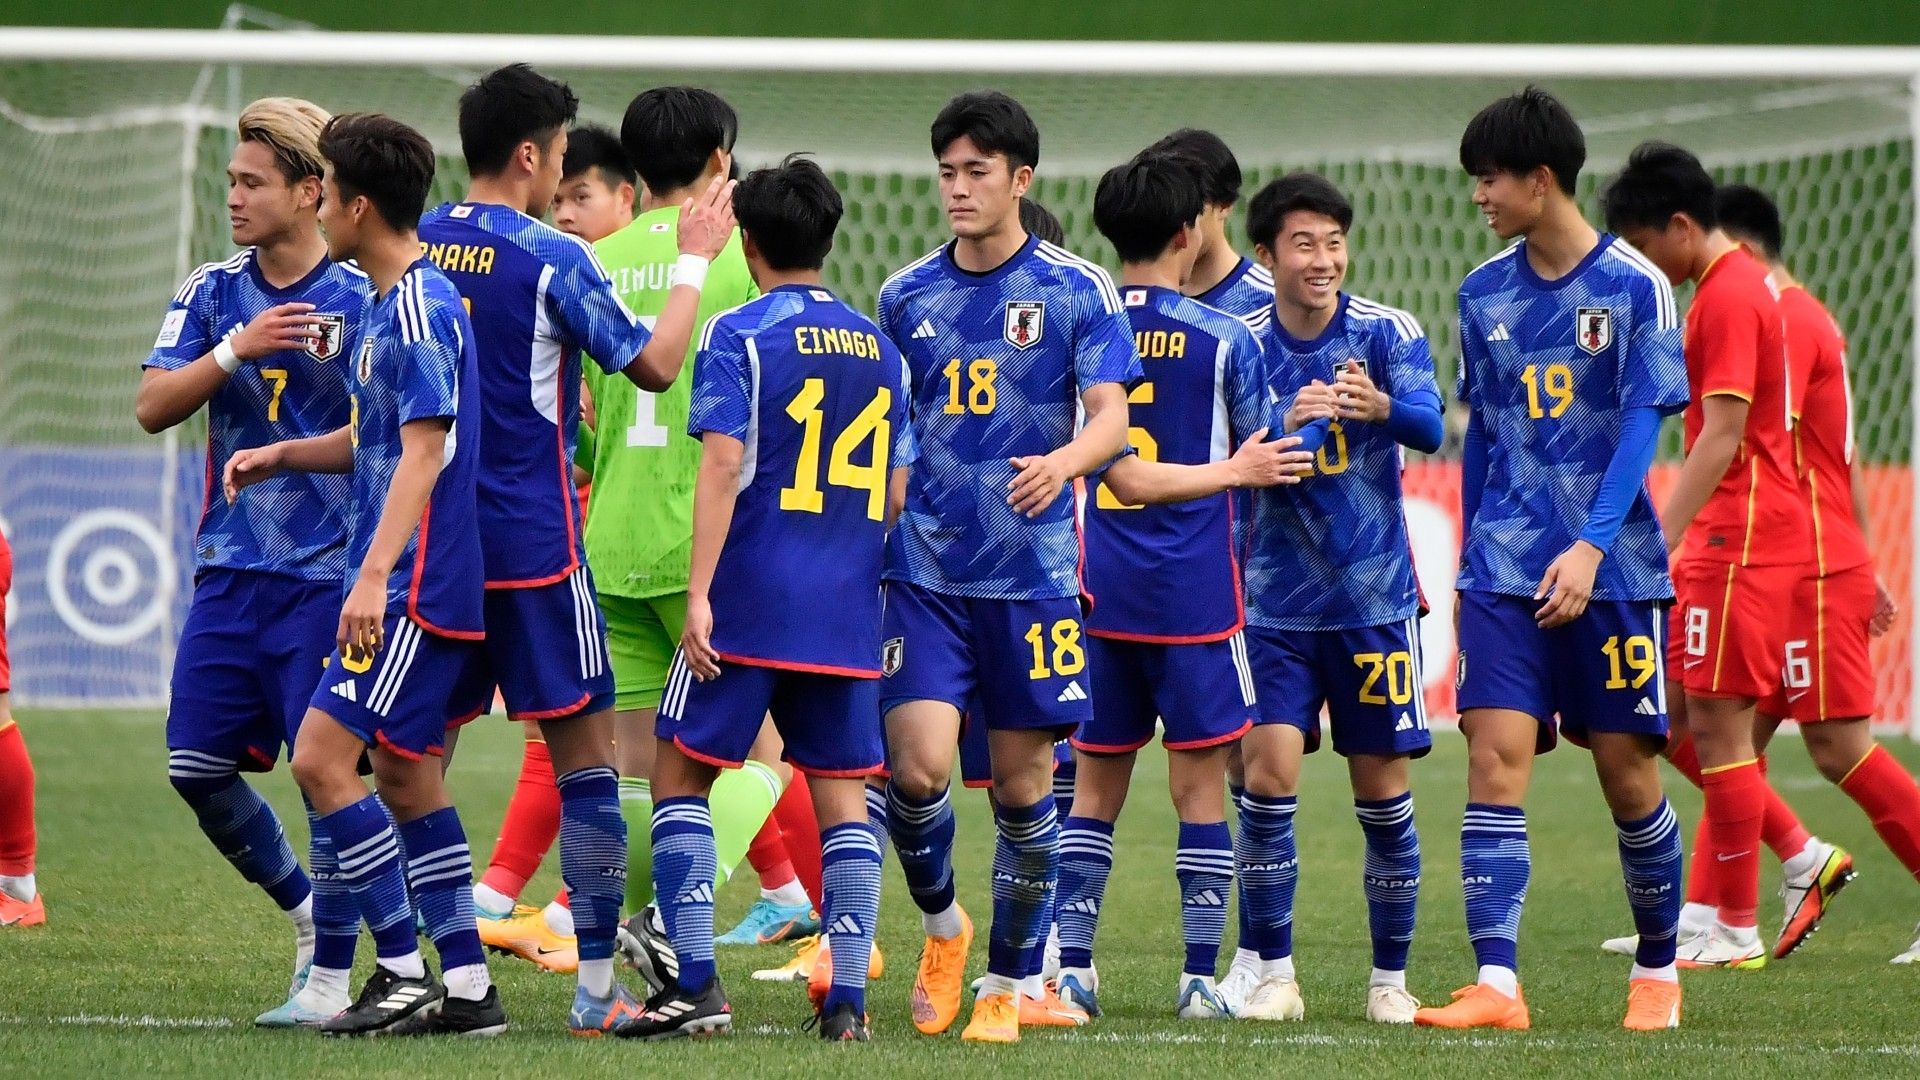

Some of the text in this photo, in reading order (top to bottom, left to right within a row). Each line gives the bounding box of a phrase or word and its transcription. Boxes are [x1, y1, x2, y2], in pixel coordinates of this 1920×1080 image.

[795, 327, 880, 361] EINAGA
[261, 369, 288, 422] 7
[943, 358, 997, 415] 18
[1520, 364, 1573, 419] 19
[780, 378, 891, 522] 14
[1294, 422, 1348, 478] 0
[1024, 618, 1085, 680] 18
[1601, 636, 1656, 690] 19
[1353, 651, 1412, 705] 20
[1243, 856, 1298, 871] JAPAN
